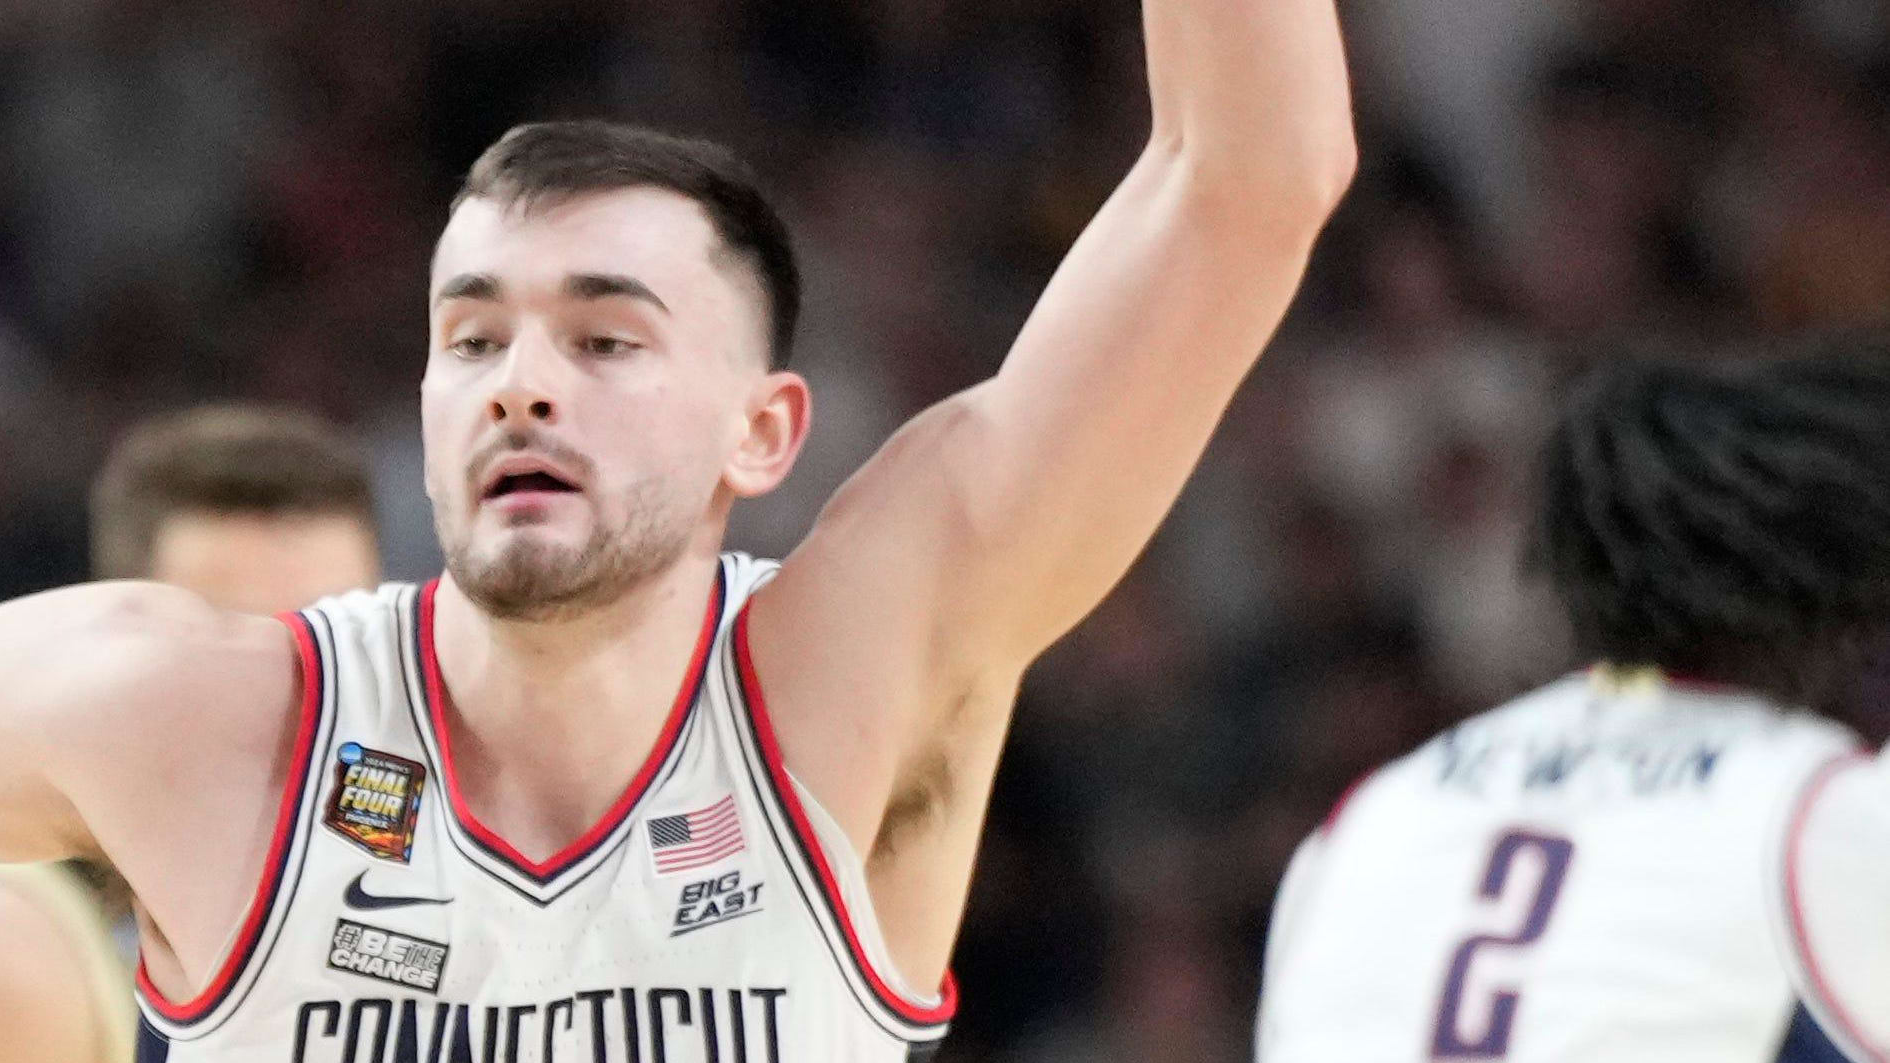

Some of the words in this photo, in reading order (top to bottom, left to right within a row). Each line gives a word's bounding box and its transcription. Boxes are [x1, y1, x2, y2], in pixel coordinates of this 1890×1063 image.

[344, 764, 407, 797] FINAL
[339, 786, 404, 818] FOUR
[674, 882, 764, 926] EAST
[679, 870, 740, 904] BIG
[1429, 828, 1574, 1062] 2
[329, 948, 439, 989] CHANGE
